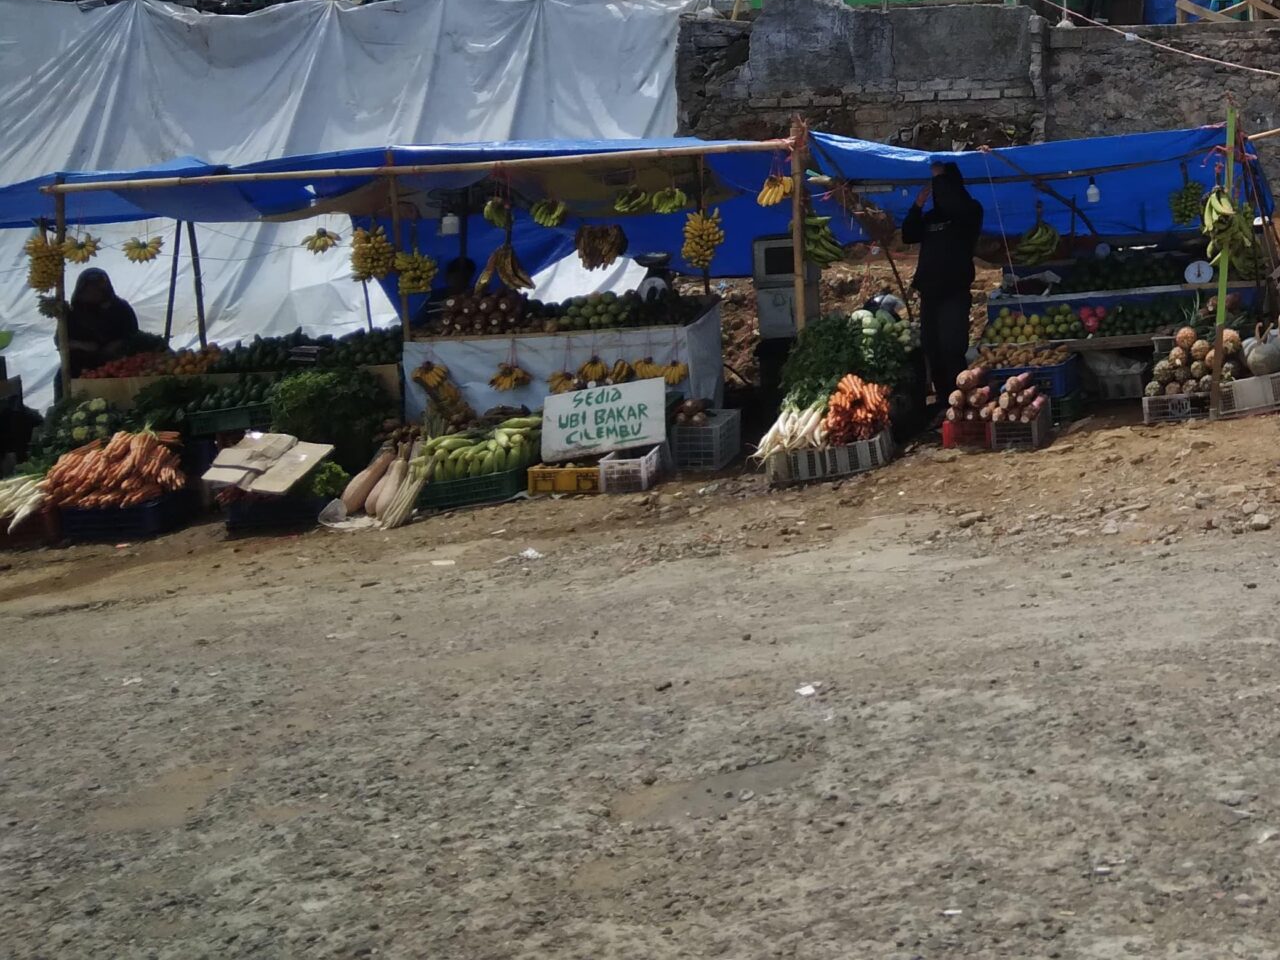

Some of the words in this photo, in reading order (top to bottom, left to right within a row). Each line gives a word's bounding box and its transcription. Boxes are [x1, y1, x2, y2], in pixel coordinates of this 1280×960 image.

[558, 410, 587, 430] UBI
[594, 403, 648, 424] BAKAR
[565, 422, 642, 445] CILEMBU
